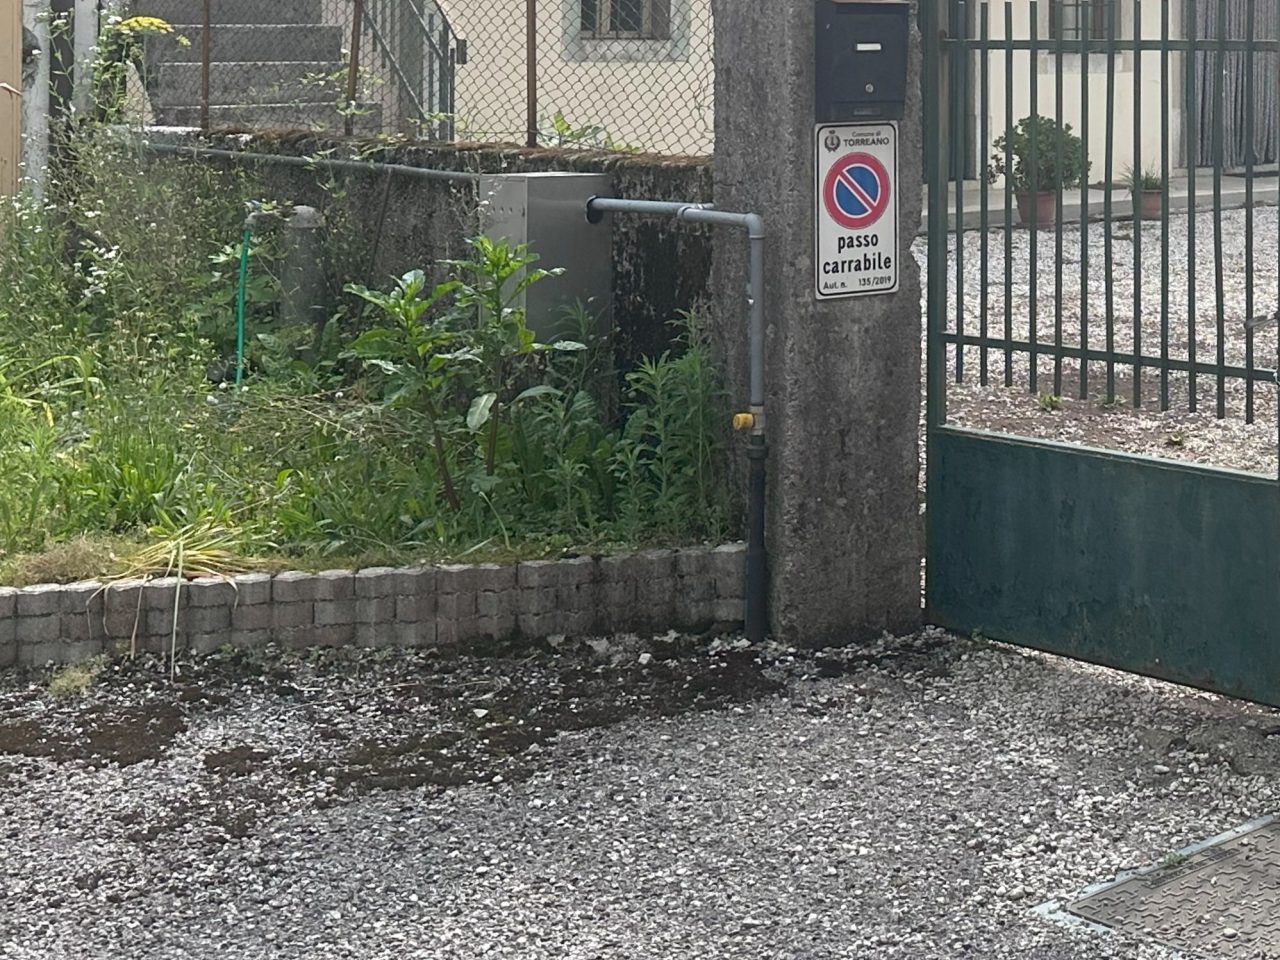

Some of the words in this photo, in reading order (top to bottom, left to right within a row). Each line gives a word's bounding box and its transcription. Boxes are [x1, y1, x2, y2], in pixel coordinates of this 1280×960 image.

[843, 137, 889, 147] TORREANO
[838, 233, 879, 254] passo
[823, 251, 892, 275] carrabile
[858, 275, 891, 287] 135/2019
